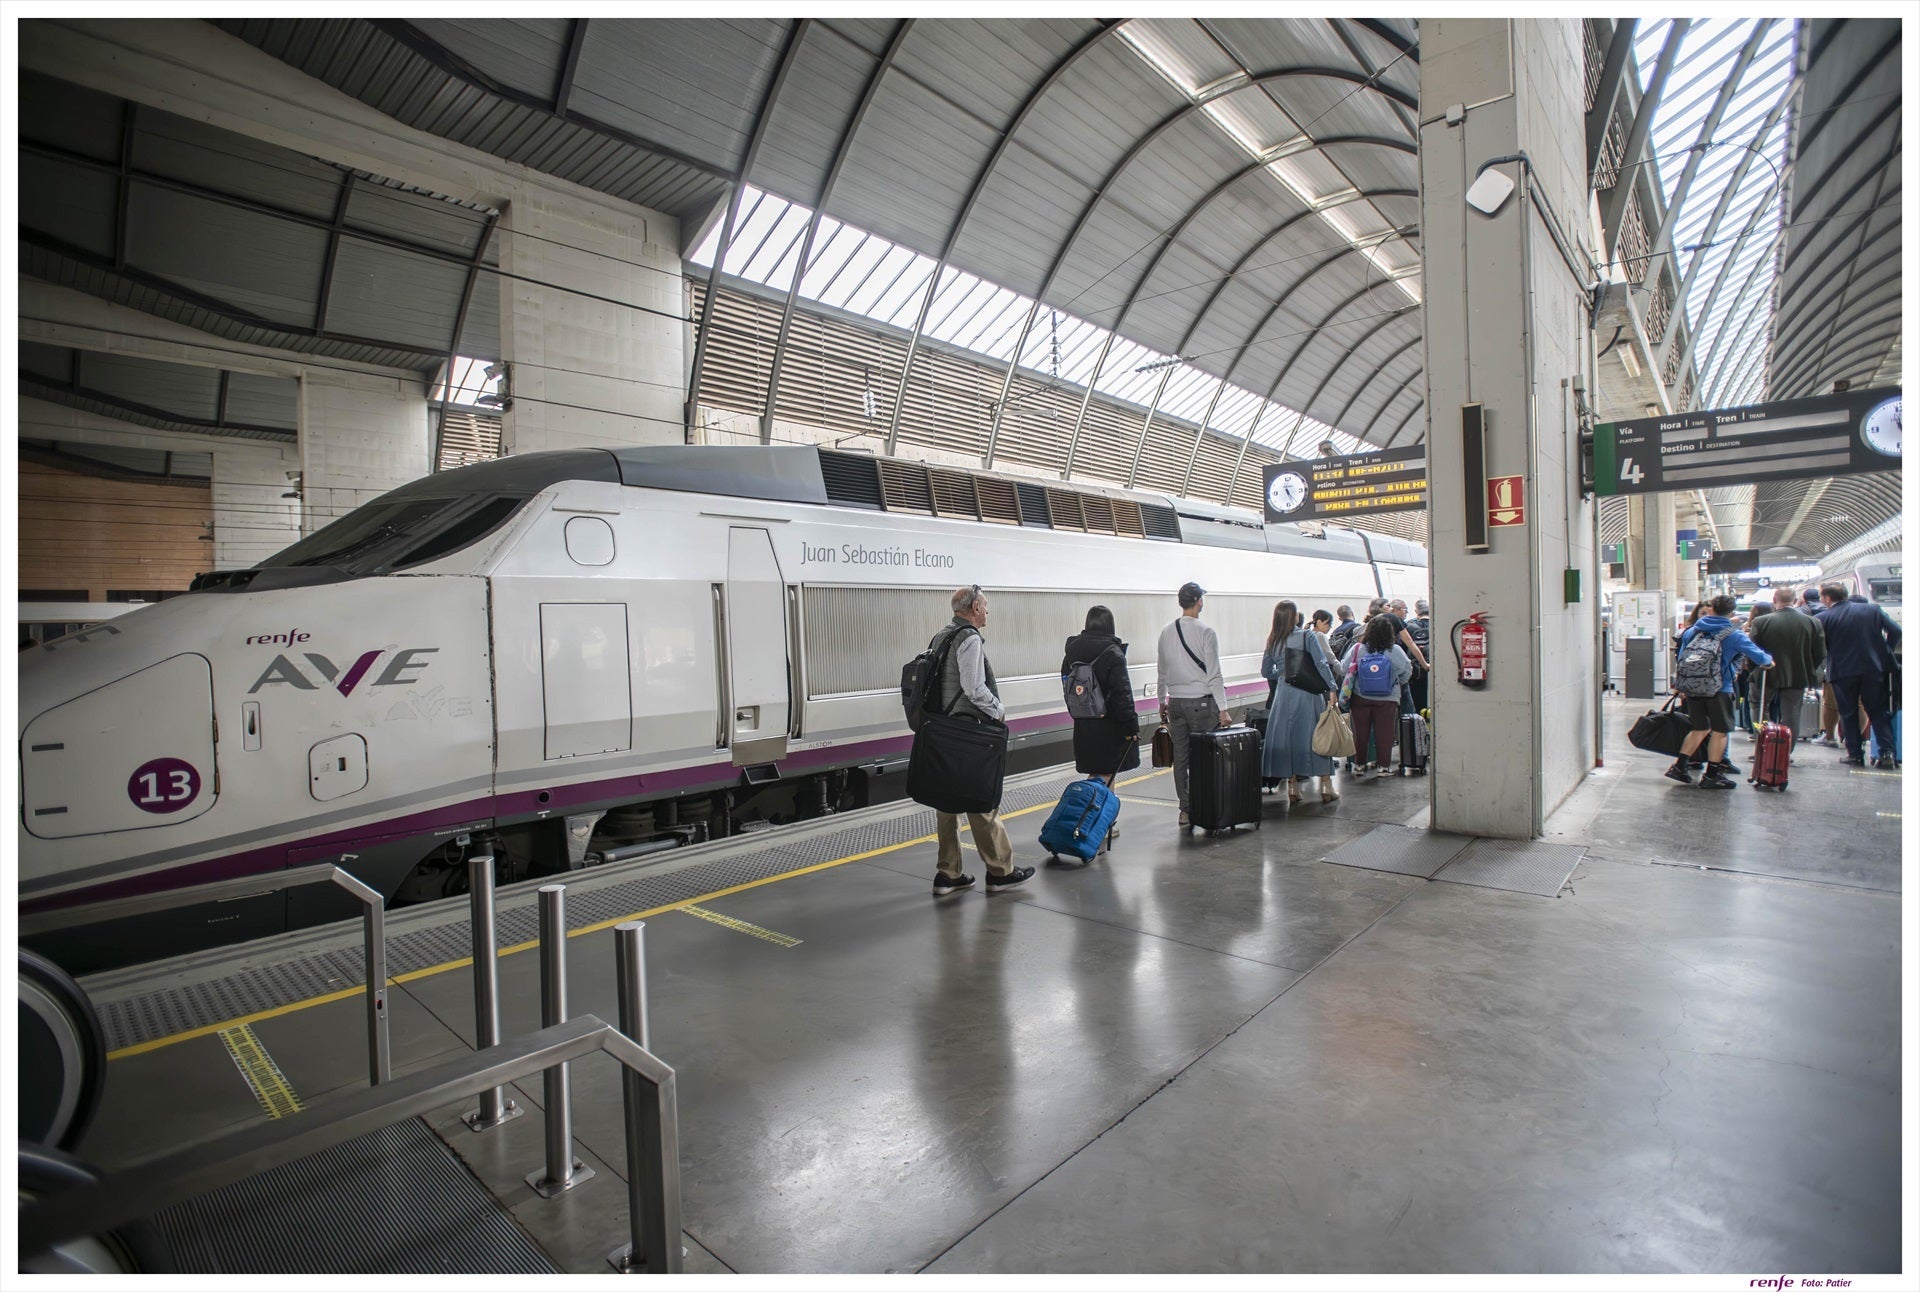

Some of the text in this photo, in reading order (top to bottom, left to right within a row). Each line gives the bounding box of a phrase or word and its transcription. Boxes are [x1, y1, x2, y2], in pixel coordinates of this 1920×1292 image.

[1619, 427, 1633, 435] Vía
[1660, 421, 1682, 431] Hora
[1715, 414, 1737, 424] Tren
[1660, 440, 1741, 454] Destino DESTINATION
[1349, 458, 1363, 466] Tren
[1620, 457, 1645, 485] 4
[801, 541, 954, 569] Juan Sebastián Elcano
[1701, 548, 1711, 559] 4
[245, 627, 311, 649] renfe
[247, 647, 441, 698] AVE
[808, 740, 833, 749] ALSTOM
[138, 770, 192, 804] 13
